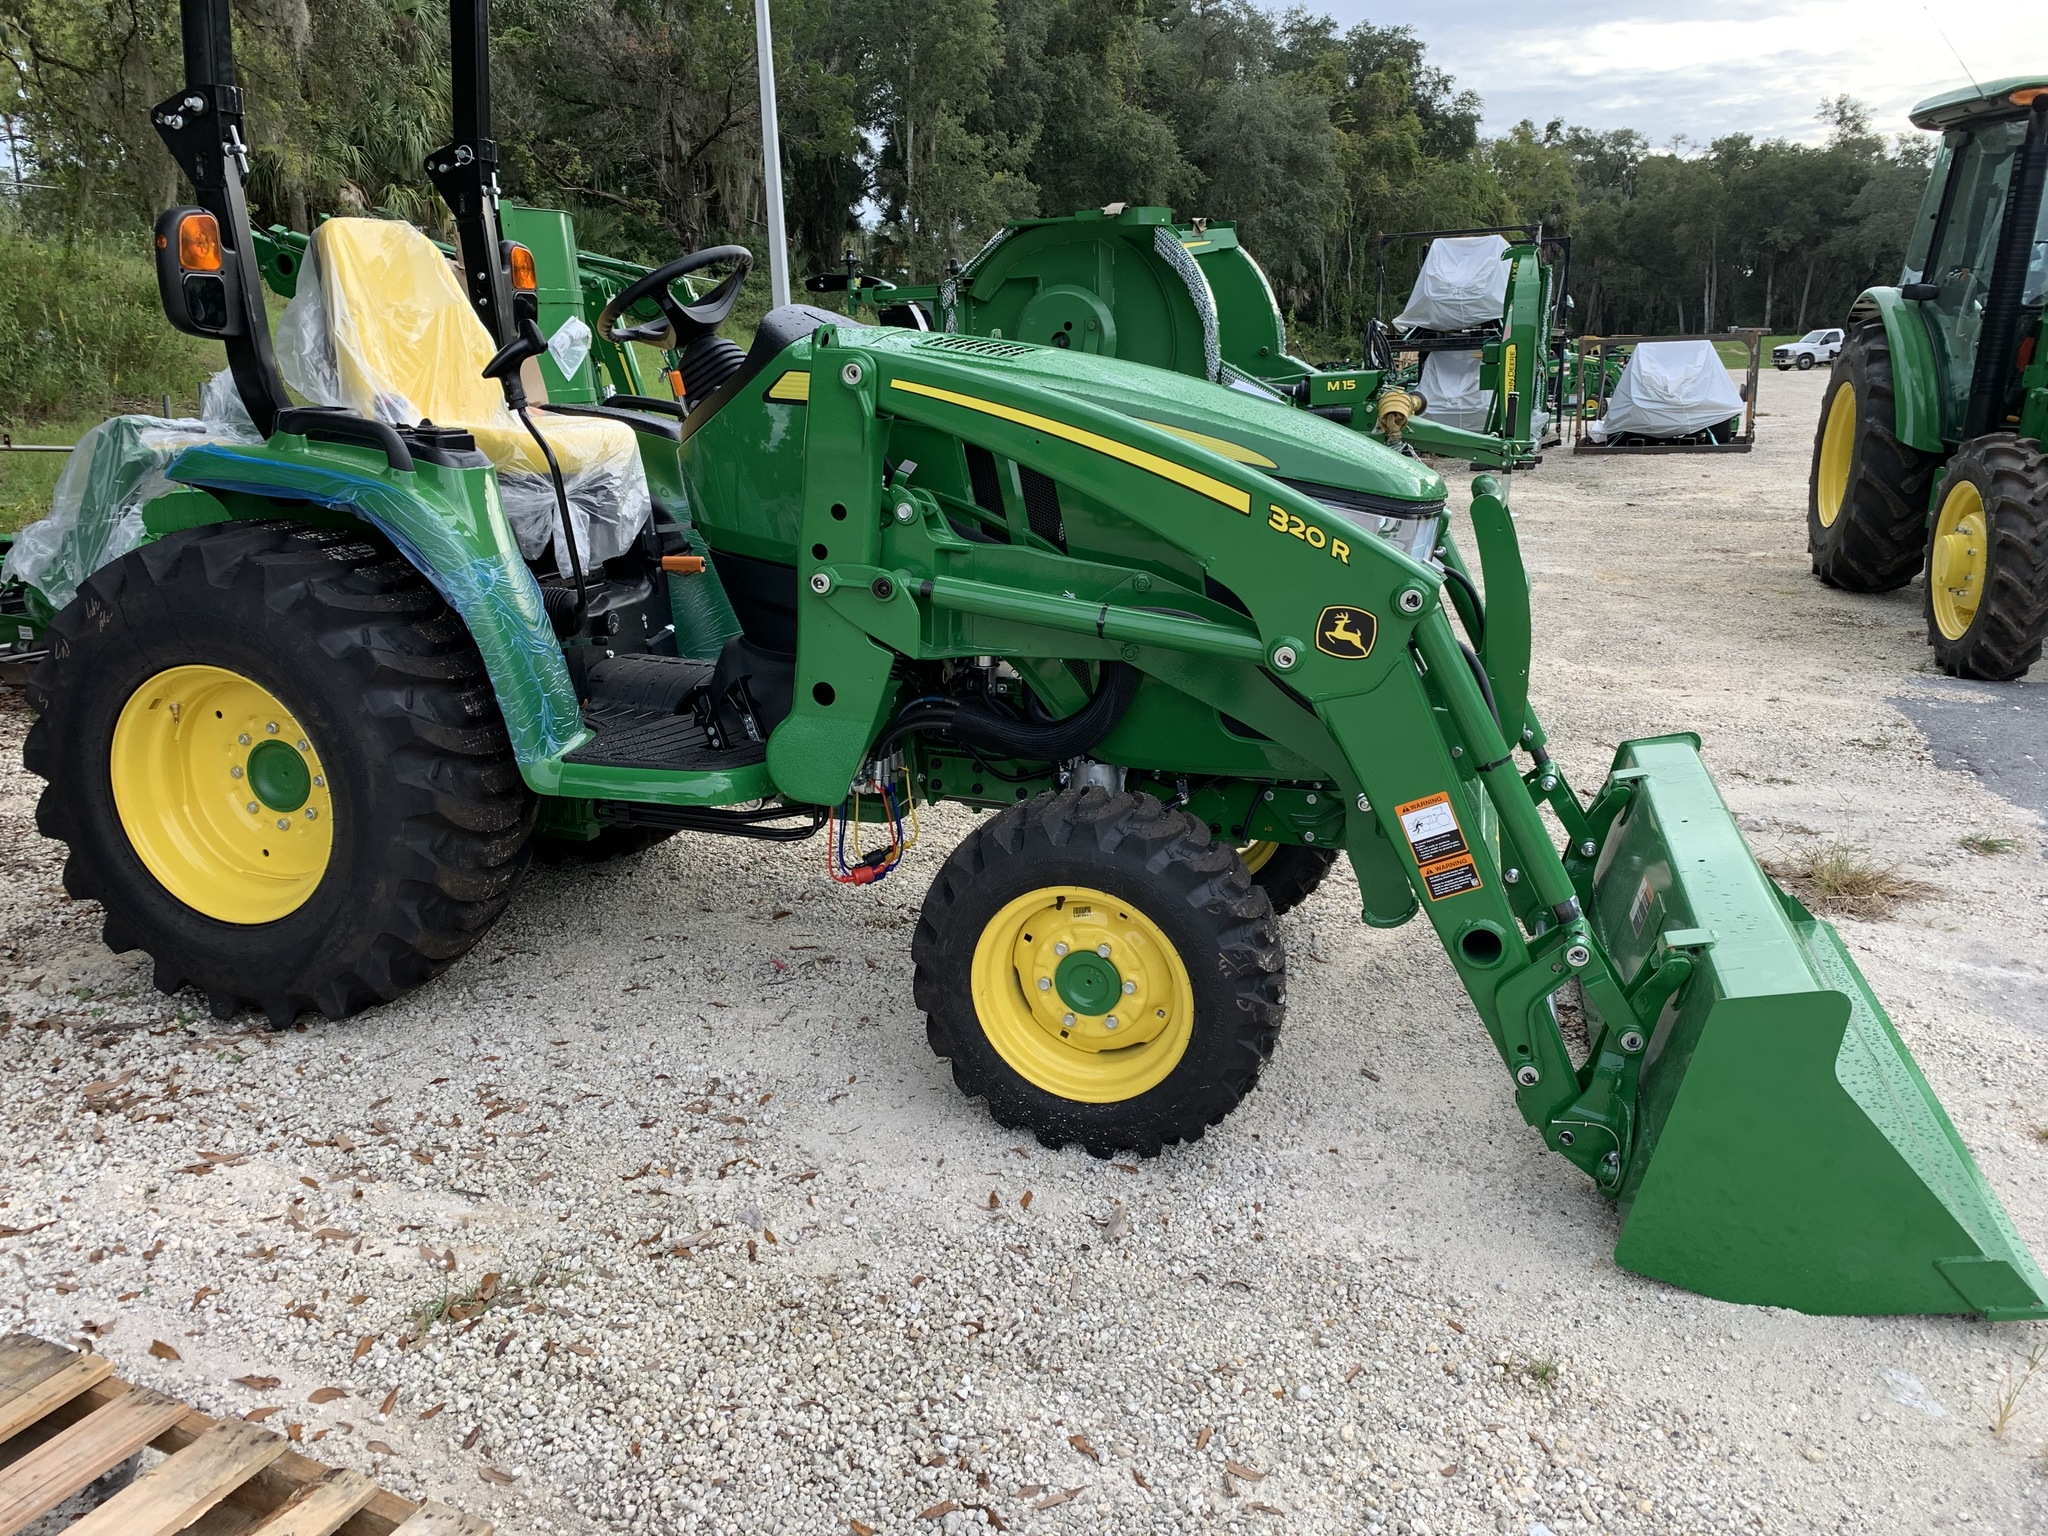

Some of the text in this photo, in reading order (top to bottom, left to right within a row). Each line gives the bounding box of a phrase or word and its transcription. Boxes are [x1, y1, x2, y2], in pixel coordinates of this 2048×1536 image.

[1507, 350, 1515, 377] DEERE
[1327, 379, 1357, 392] M 15
[1268, 504, 1351, 566] 320 R
[1409, 795, 1443, 810] WARNING
[1434, 857, 1468, 871] WARNING
